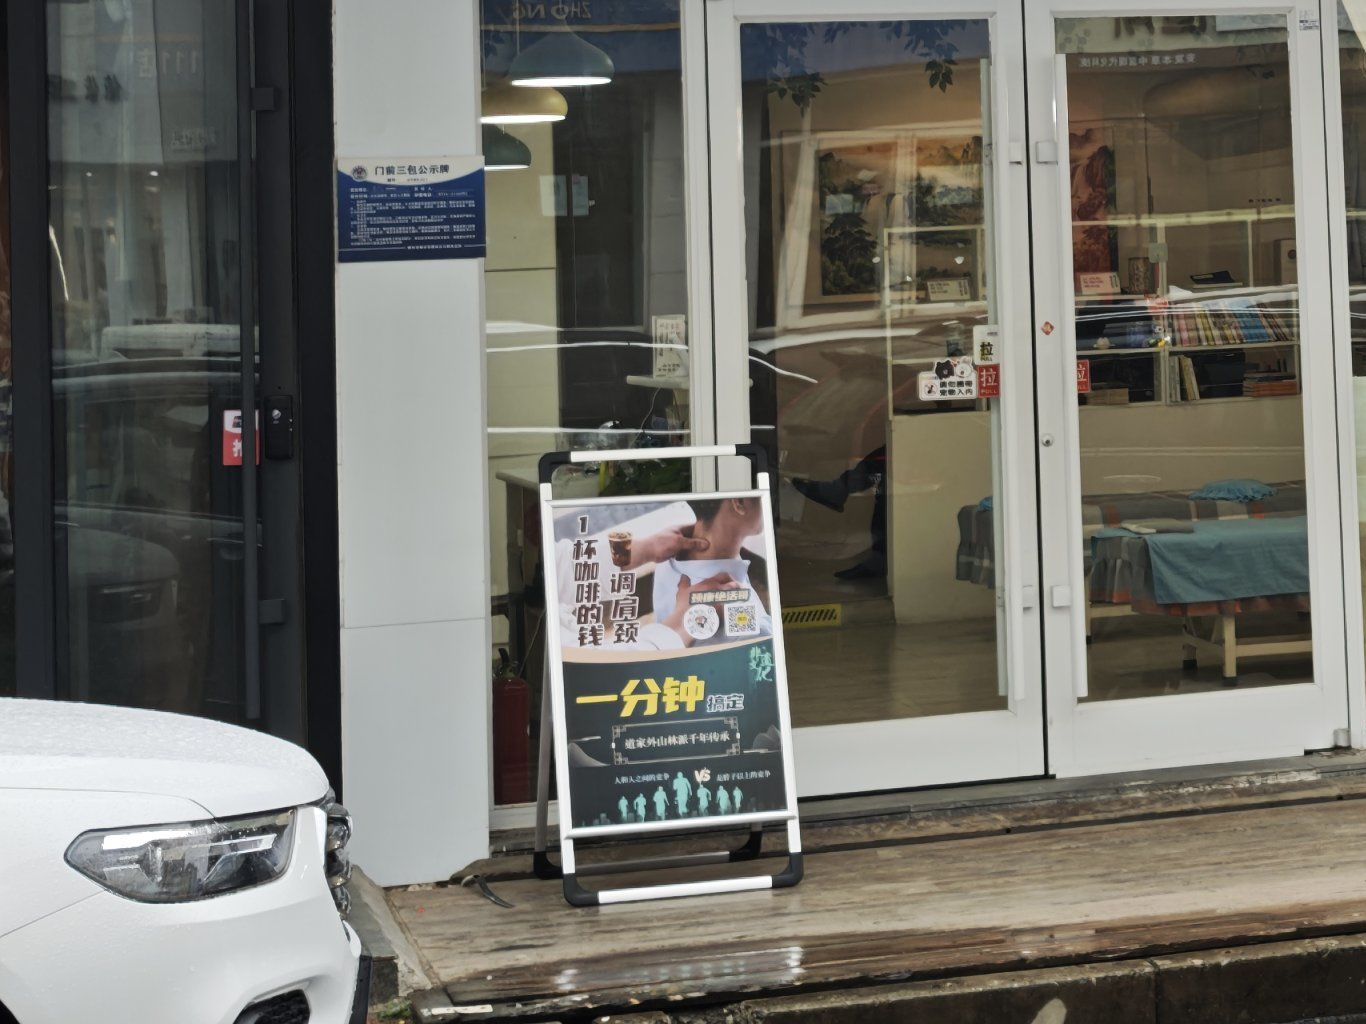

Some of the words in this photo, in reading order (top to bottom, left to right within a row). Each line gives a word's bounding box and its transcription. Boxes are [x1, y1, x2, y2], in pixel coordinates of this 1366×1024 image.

[375, 164, 450, 176] 门前三包公示牌
[980, 367, 998, 388] 拉
[572, 515, 604, 648] 1杯咖啡的钱
[609, 571, 640, 645] 调肩颈
[576, 675, 706, 717] 一分钟
[705, 694, 745, 714] 搞定
[694, 767, 711, 783] VS
